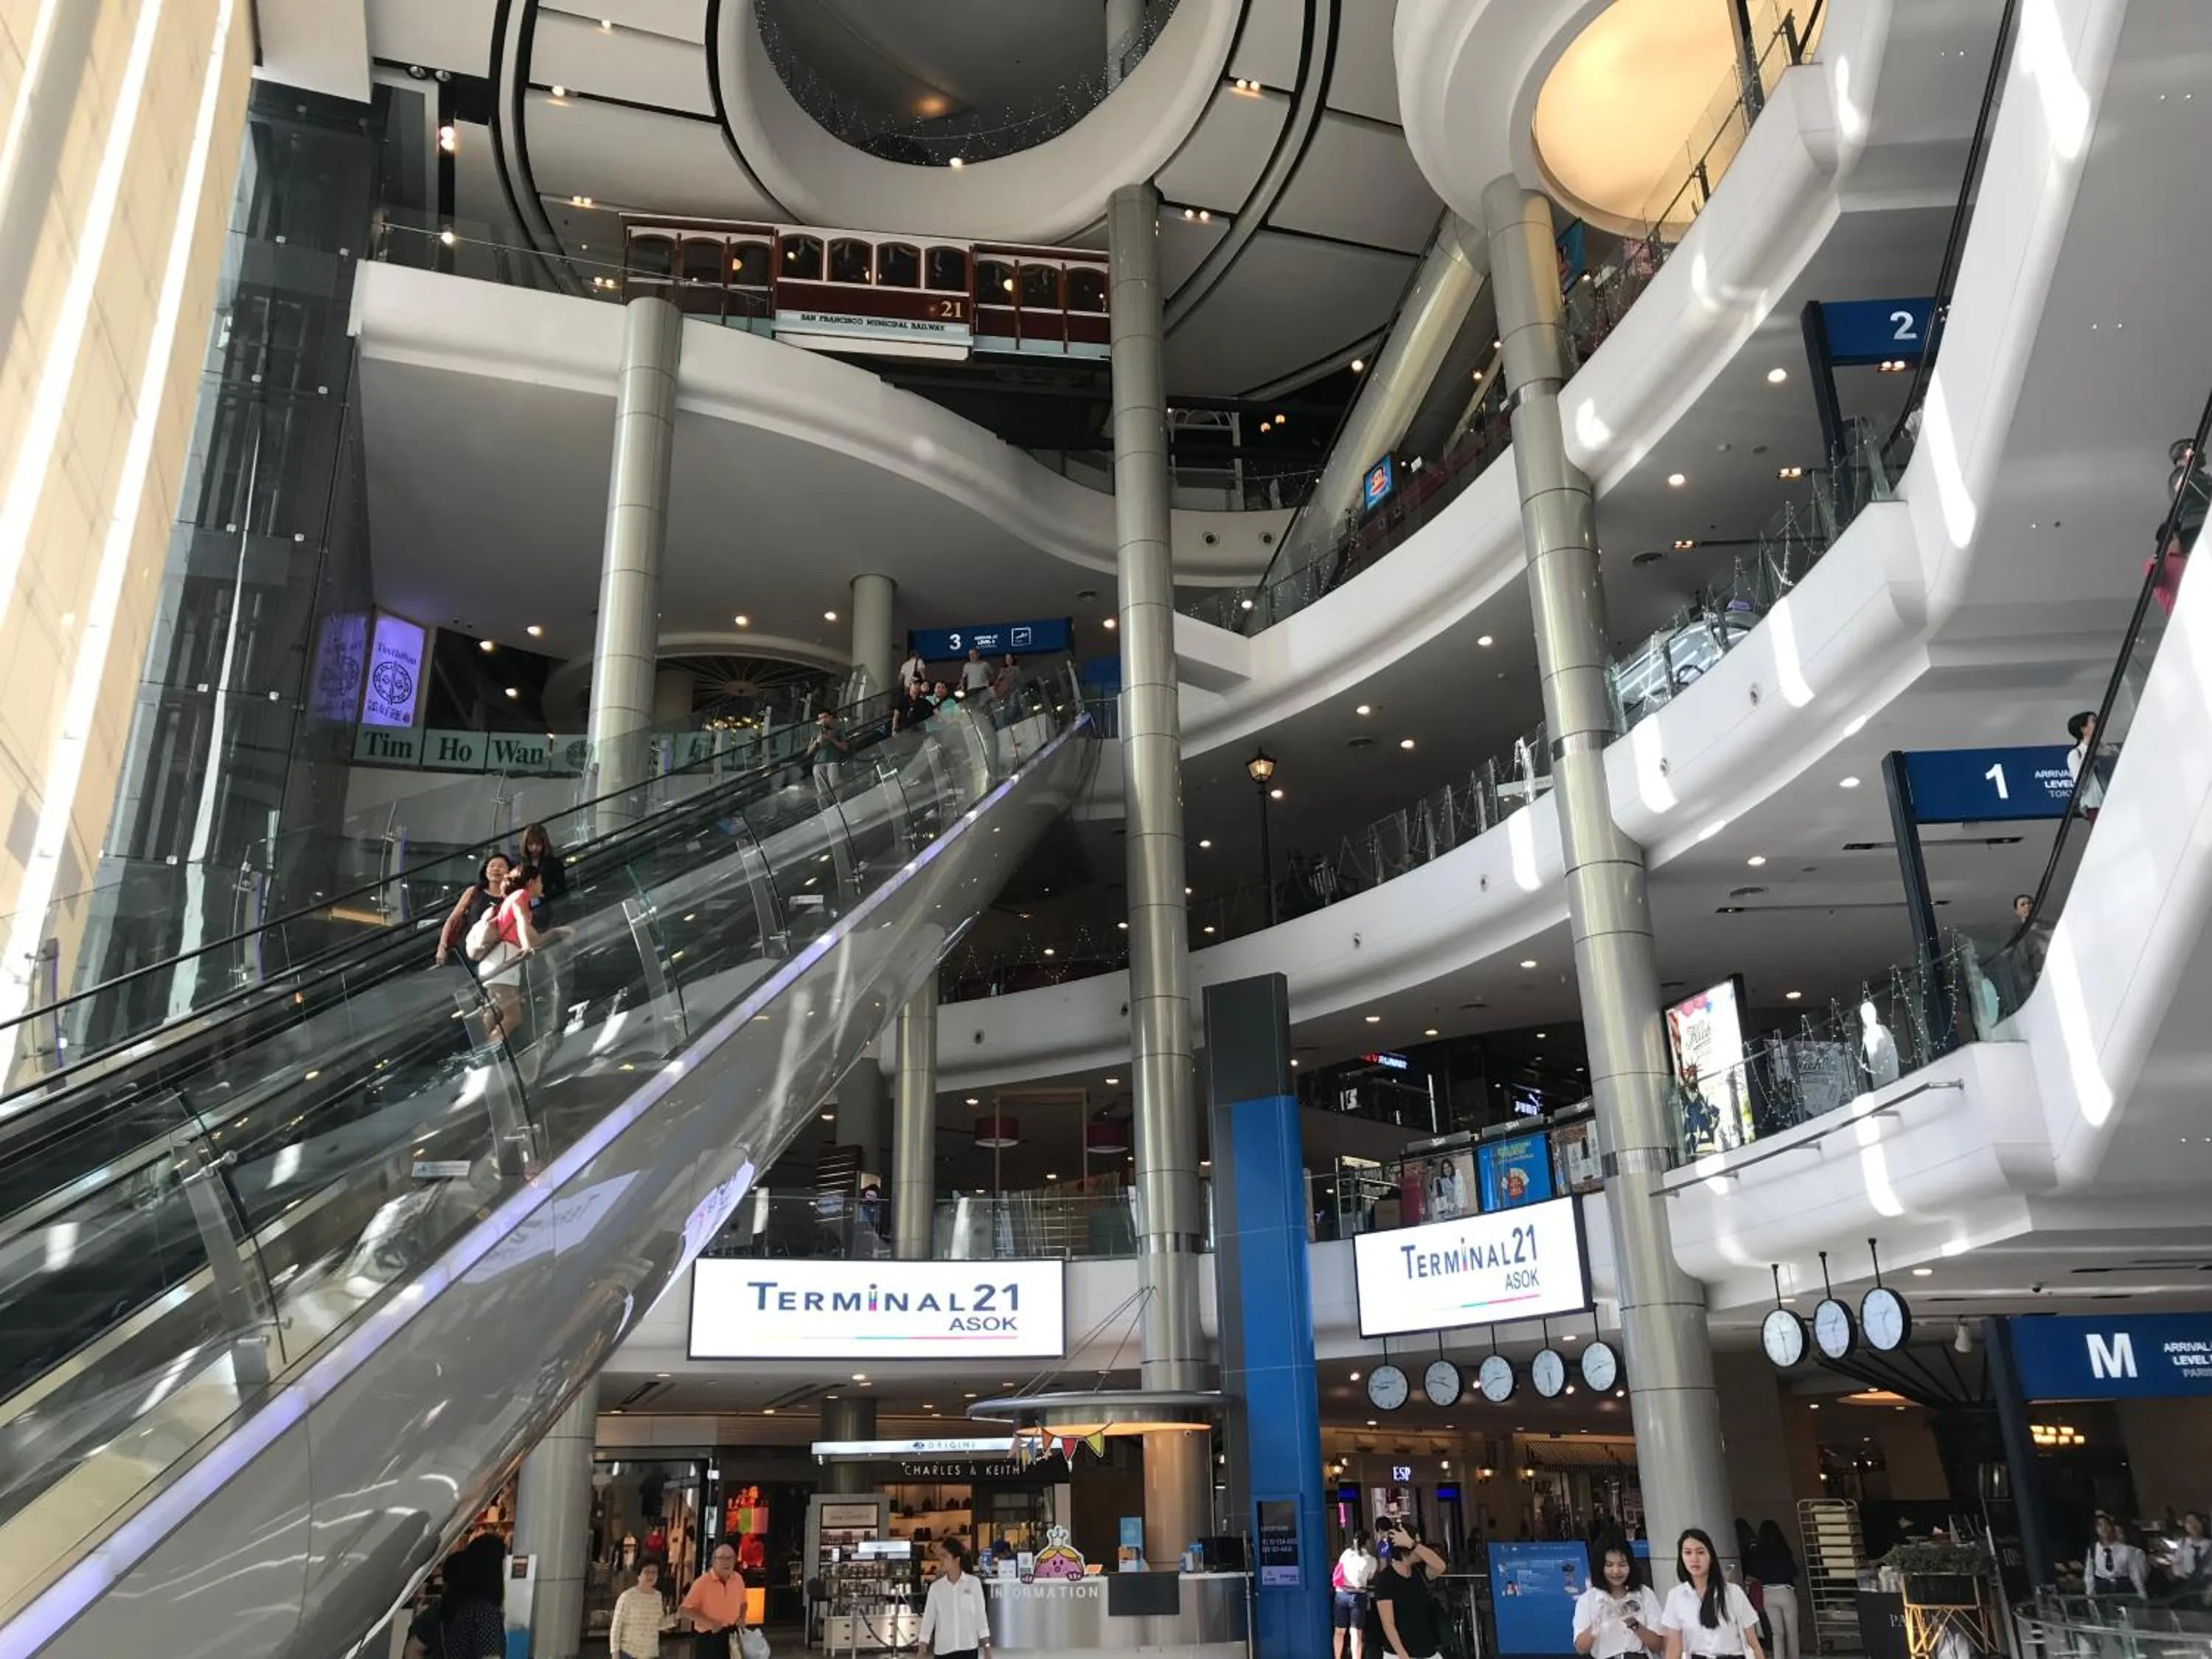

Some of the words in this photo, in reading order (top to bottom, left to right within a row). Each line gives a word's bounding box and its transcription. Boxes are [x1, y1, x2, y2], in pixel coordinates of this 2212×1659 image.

[941, 301, 962, 318] 21
[819, 315, 863, 325] FRANCISCO
[866, 319, 908, 329] MUNICIPAL
[911, 322, 945, 332] RAILWAY
[1890, 310, 1917, 340] 2
[949, 633, 961, 650] 3
[365, 731, 412, 759] Tim
[438, 737, 473, 762] Ho
[493, 740, 544, 765] Wan
[1986, 763, 2009, 799] 1
[2045, 779, 2075, 788] LEVEL
[1505, 1267, 1540, 1291] ASOK
[948, 1317, 1018, 1331] ASOK
[2086, 1332, 2138, 1378] M
[2164, 1341, 2211, 1353] ARRIVAL
[2172, 1354, 2210, 1366] LEVEL
[905, 1465, 961, 1475] CHARLES
[970, 1465, 977, 1475] &
[985, 1464, 1020, 1475] KEITH
[990, 1585, 1099, 1599] INORMATION
